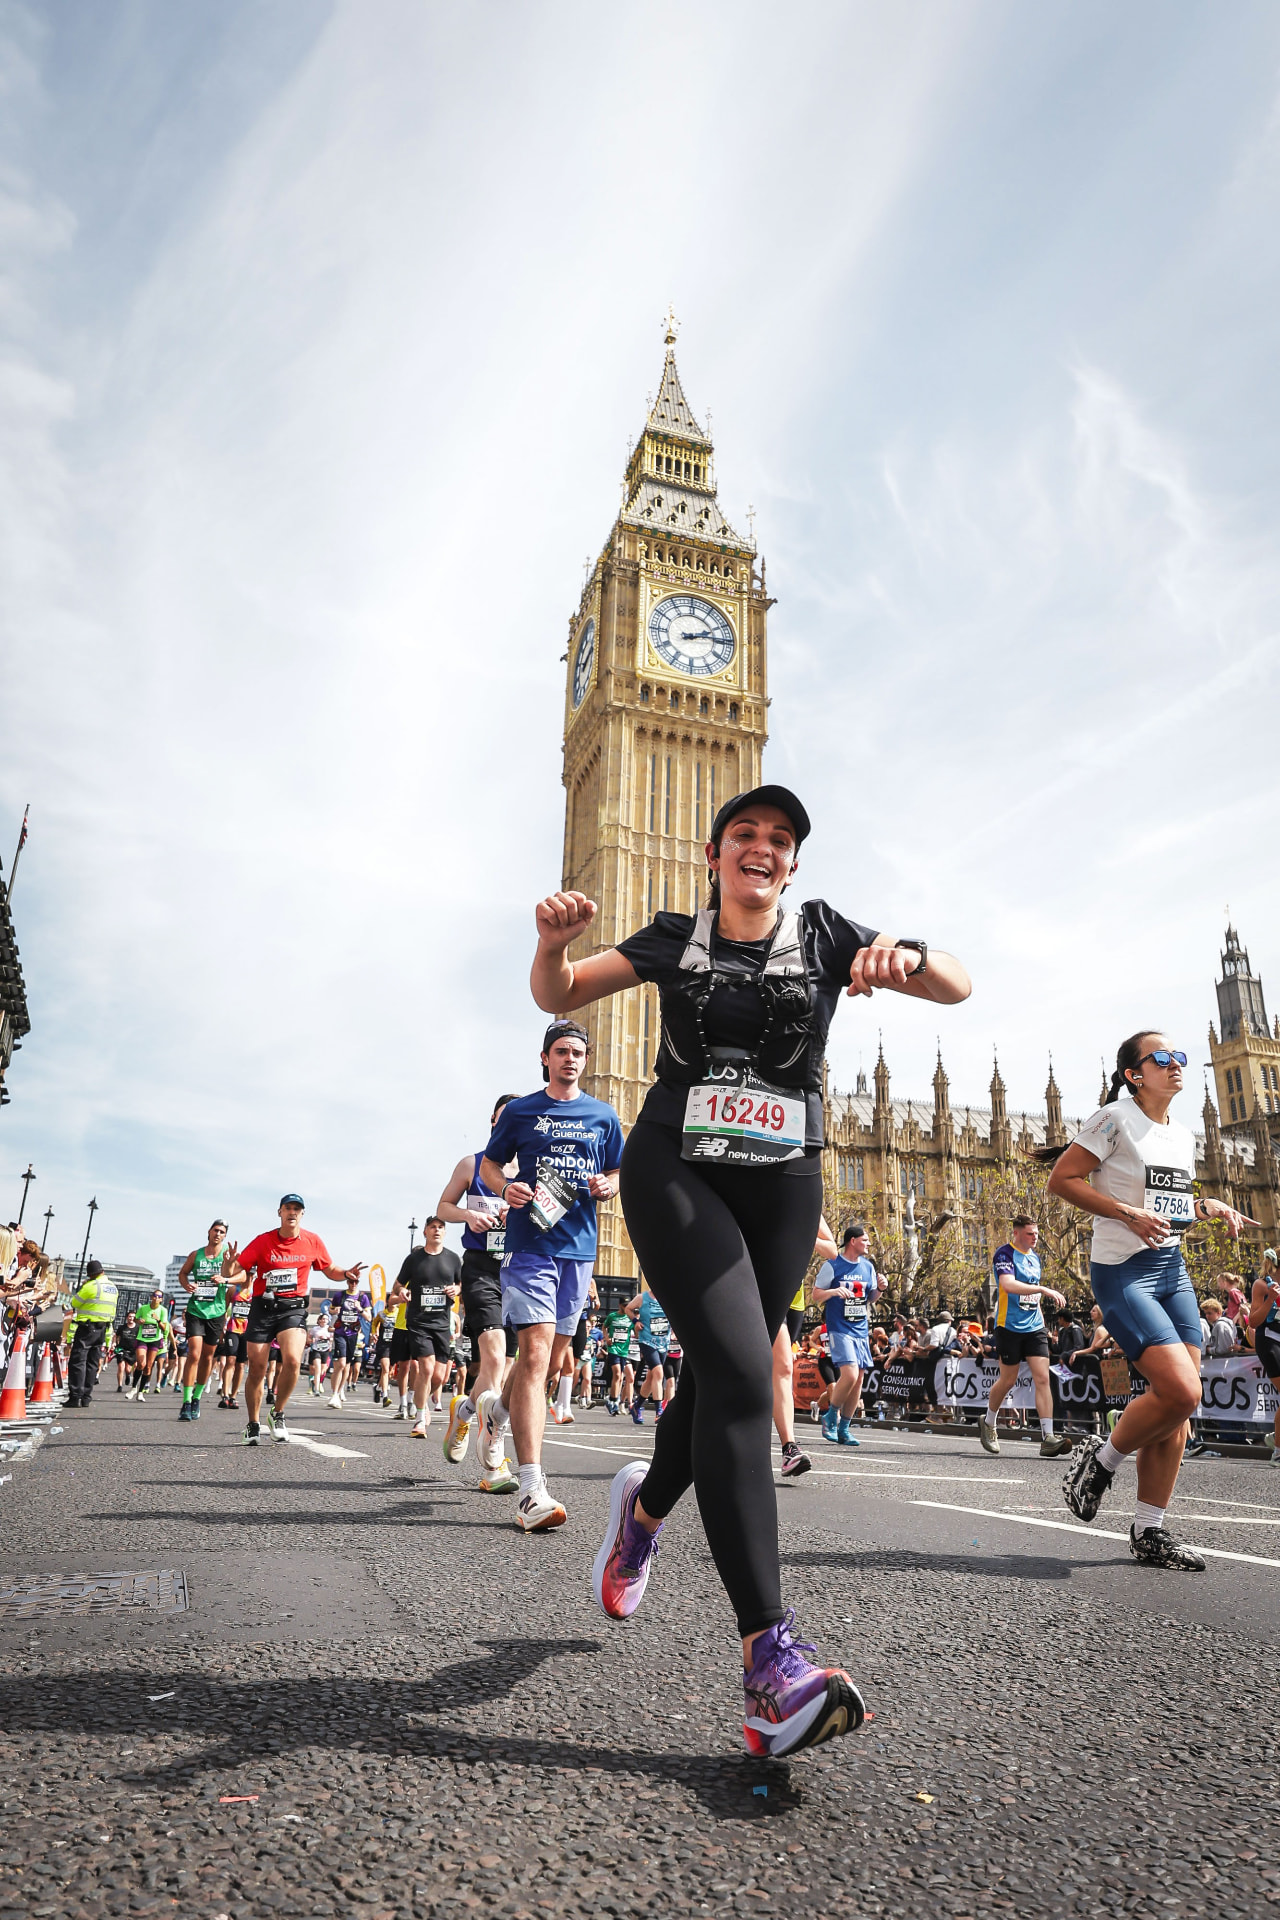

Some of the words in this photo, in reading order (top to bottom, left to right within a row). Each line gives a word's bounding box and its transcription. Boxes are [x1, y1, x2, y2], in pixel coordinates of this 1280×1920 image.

[707, 1094, 785, 1131] 15249
[552, 1120, 585, 1130] mind
[552, 1130, 597, 1142] Guernsey
[728, 1150, 749, 1160] new
[750, 1152, 786, 1163] balan
[552, 1169, 595, 1181] ATHON
[1150, 1168, 1171, 1187] tcs
[1153, 1195, 1189, 1216] 57584
[199, 1260, 223, 1268] ISAAC
[270, 1254, 307, 1263] RAMIRO
[882, 1375, 926, 1387] CONSULTANCY
[944, 1366, 978, 1399] tcs
[881, 1385, 910, 1397] SERVICES
